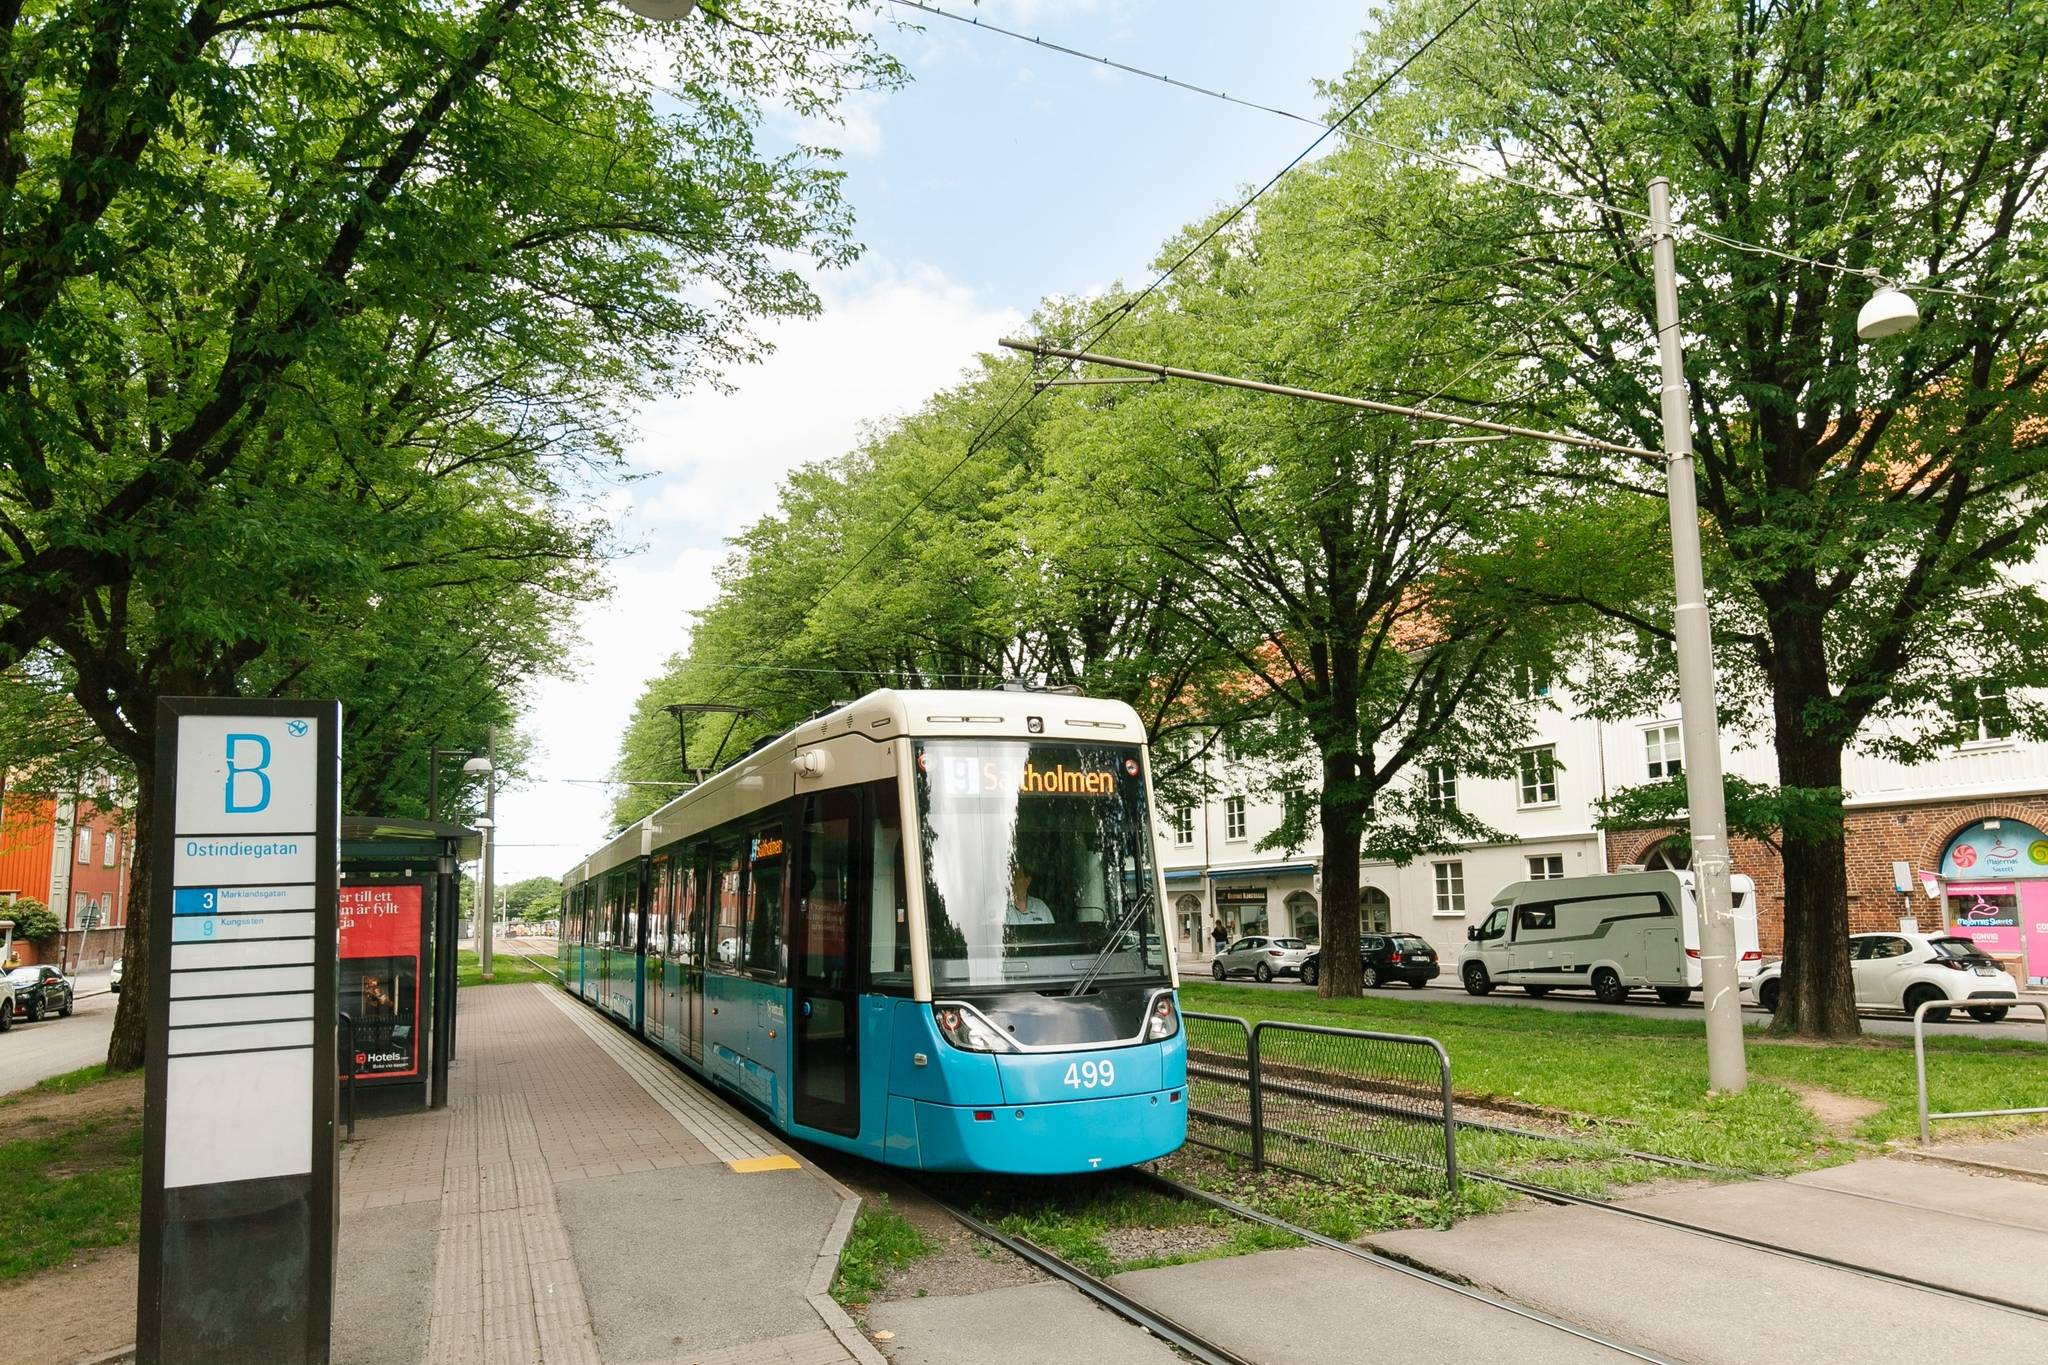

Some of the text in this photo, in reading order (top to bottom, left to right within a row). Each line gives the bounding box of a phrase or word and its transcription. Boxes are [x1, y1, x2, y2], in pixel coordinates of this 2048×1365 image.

[225, 733, 271, 814] B
[983, 763, 1114, 793] Satholmen
[186, 841, 298, 859] Ostindiegatan
[203, 890, 287, 909] 3 Marklandsgatan
[355, 890, 371, 902] till
[374, 892, 392, 902] ett
[356, 904, 371, 915] är
[373, 902, 399, 917] fyllt
[203, 918, 264, 936] 9 Kungssten
[1063, 1059, 1115, 1089] 499
